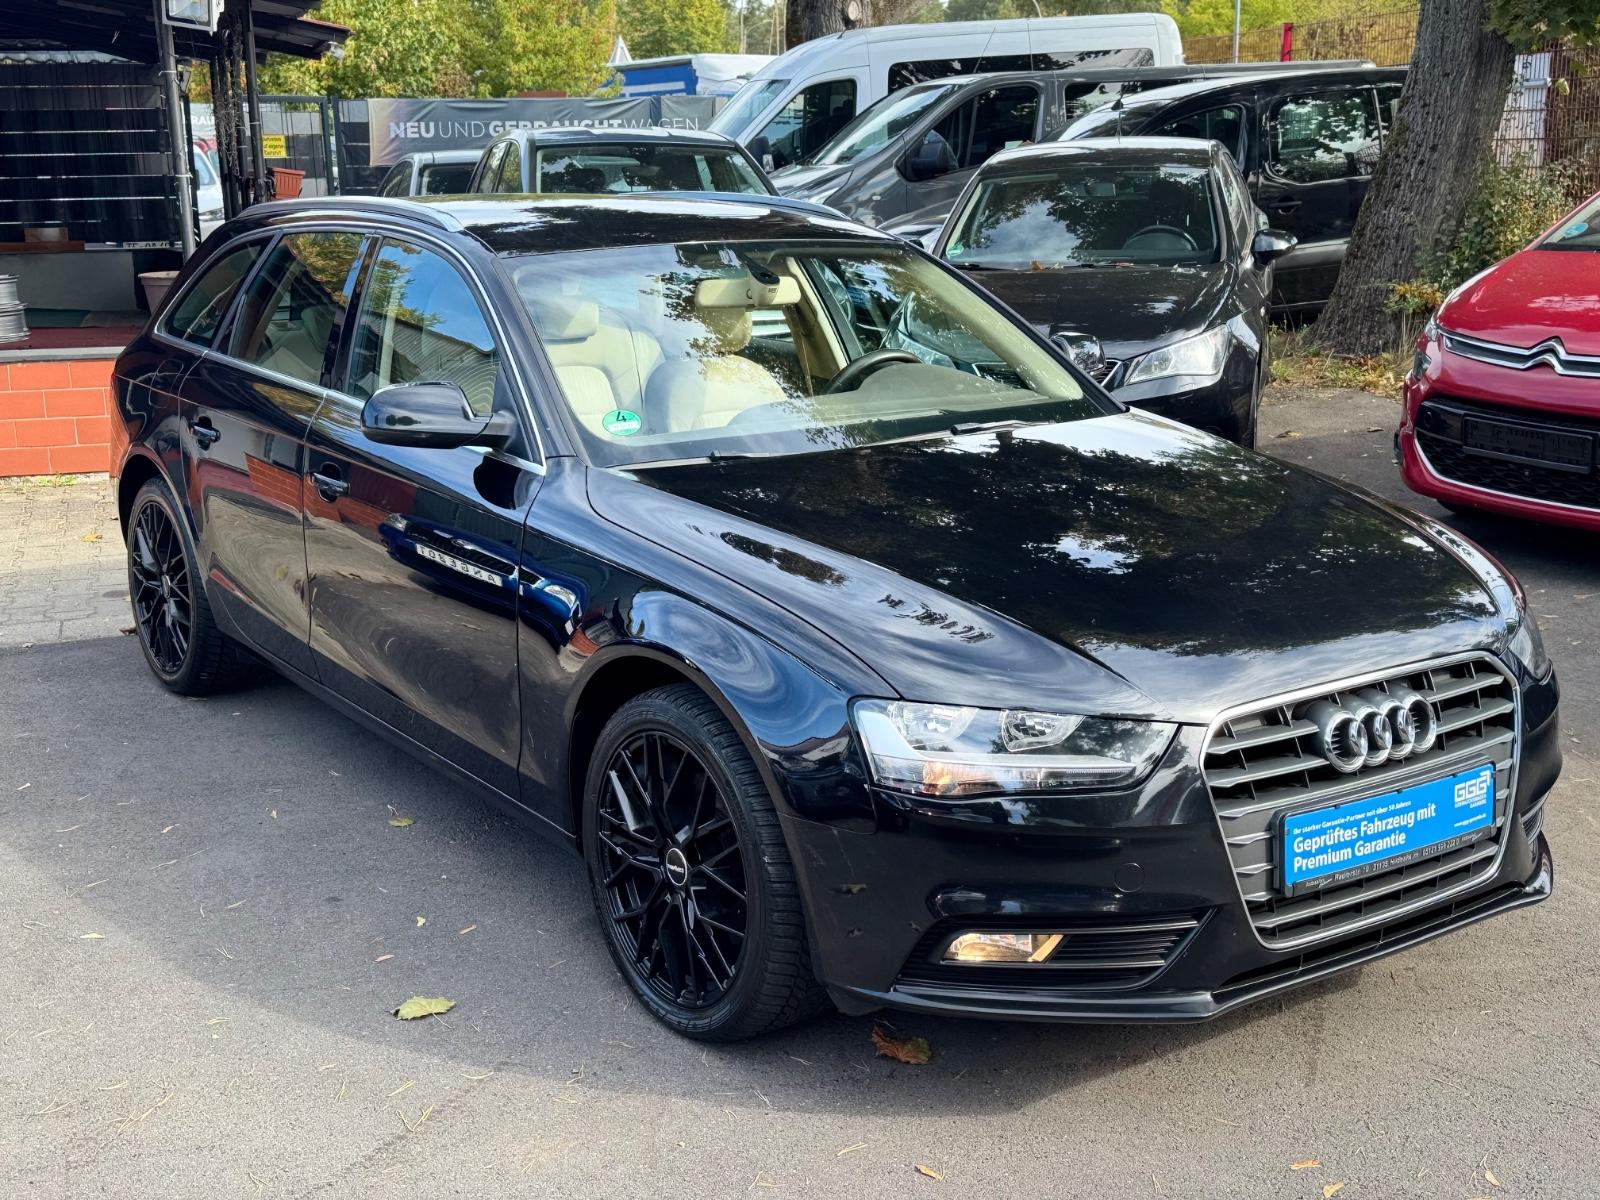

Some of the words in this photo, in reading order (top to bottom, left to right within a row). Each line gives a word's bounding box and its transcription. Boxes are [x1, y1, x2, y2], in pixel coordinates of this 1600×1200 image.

[390, 121, 435, 139] NEU
[439, 121, 485, 139] UND
[616, 411, 627, 422] 4
[1454, 775, 1487, 802] GGG
[1293, 827, 1358, 853] Geprüftes
[1360, 811, 1415, 837] Fahrzeug
[1417, 802, 1437, 821] mit
[1293, 847, 1352, 872] Premium
[1354, 831, 1406, 856] Garantie
